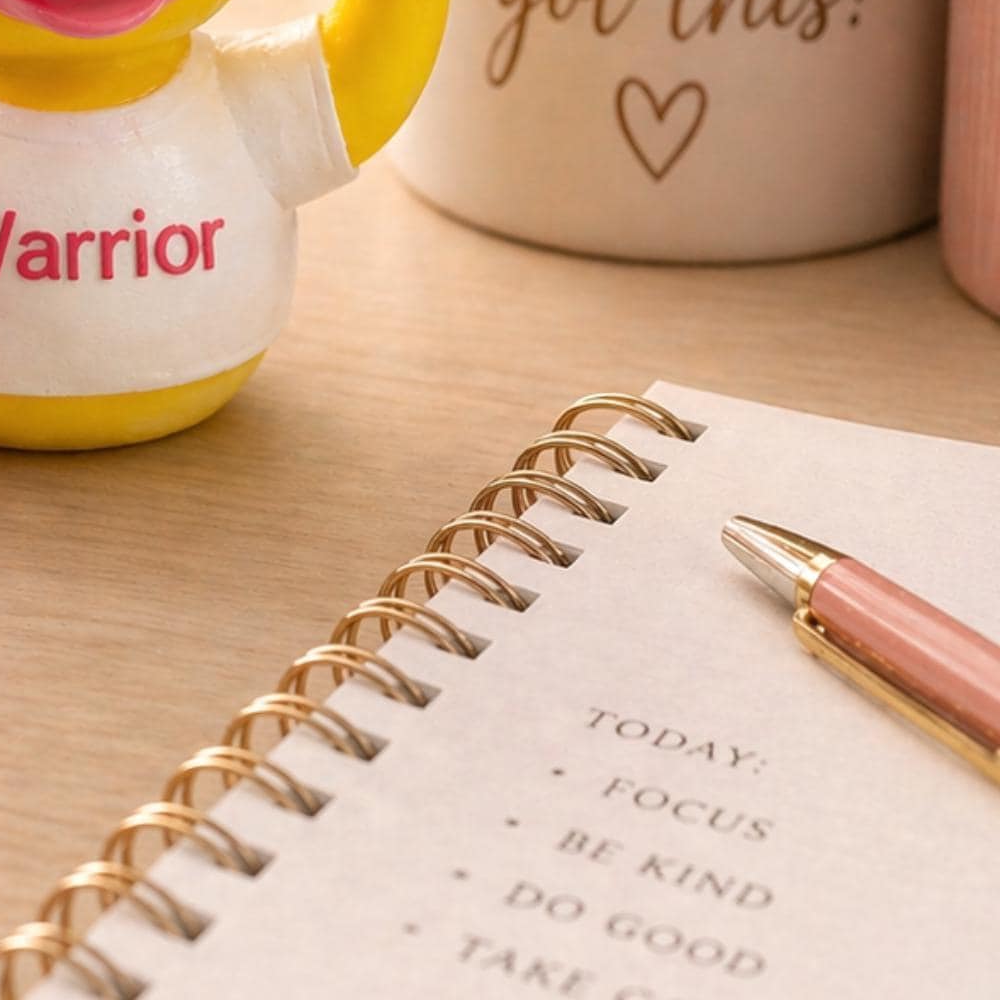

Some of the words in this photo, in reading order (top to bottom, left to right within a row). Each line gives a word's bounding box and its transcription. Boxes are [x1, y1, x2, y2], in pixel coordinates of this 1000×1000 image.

[585, 707, 768, 775] TODAY:
[602, 777, 774, 842] FOCUS
[556, 829, 624, 863] BE
[638, 853, 775, 910] KIND
[504, 881, 585, 923] DO
[605, 911, 767, 979] GOOD
[458, 933, 597, 997] TAKE
